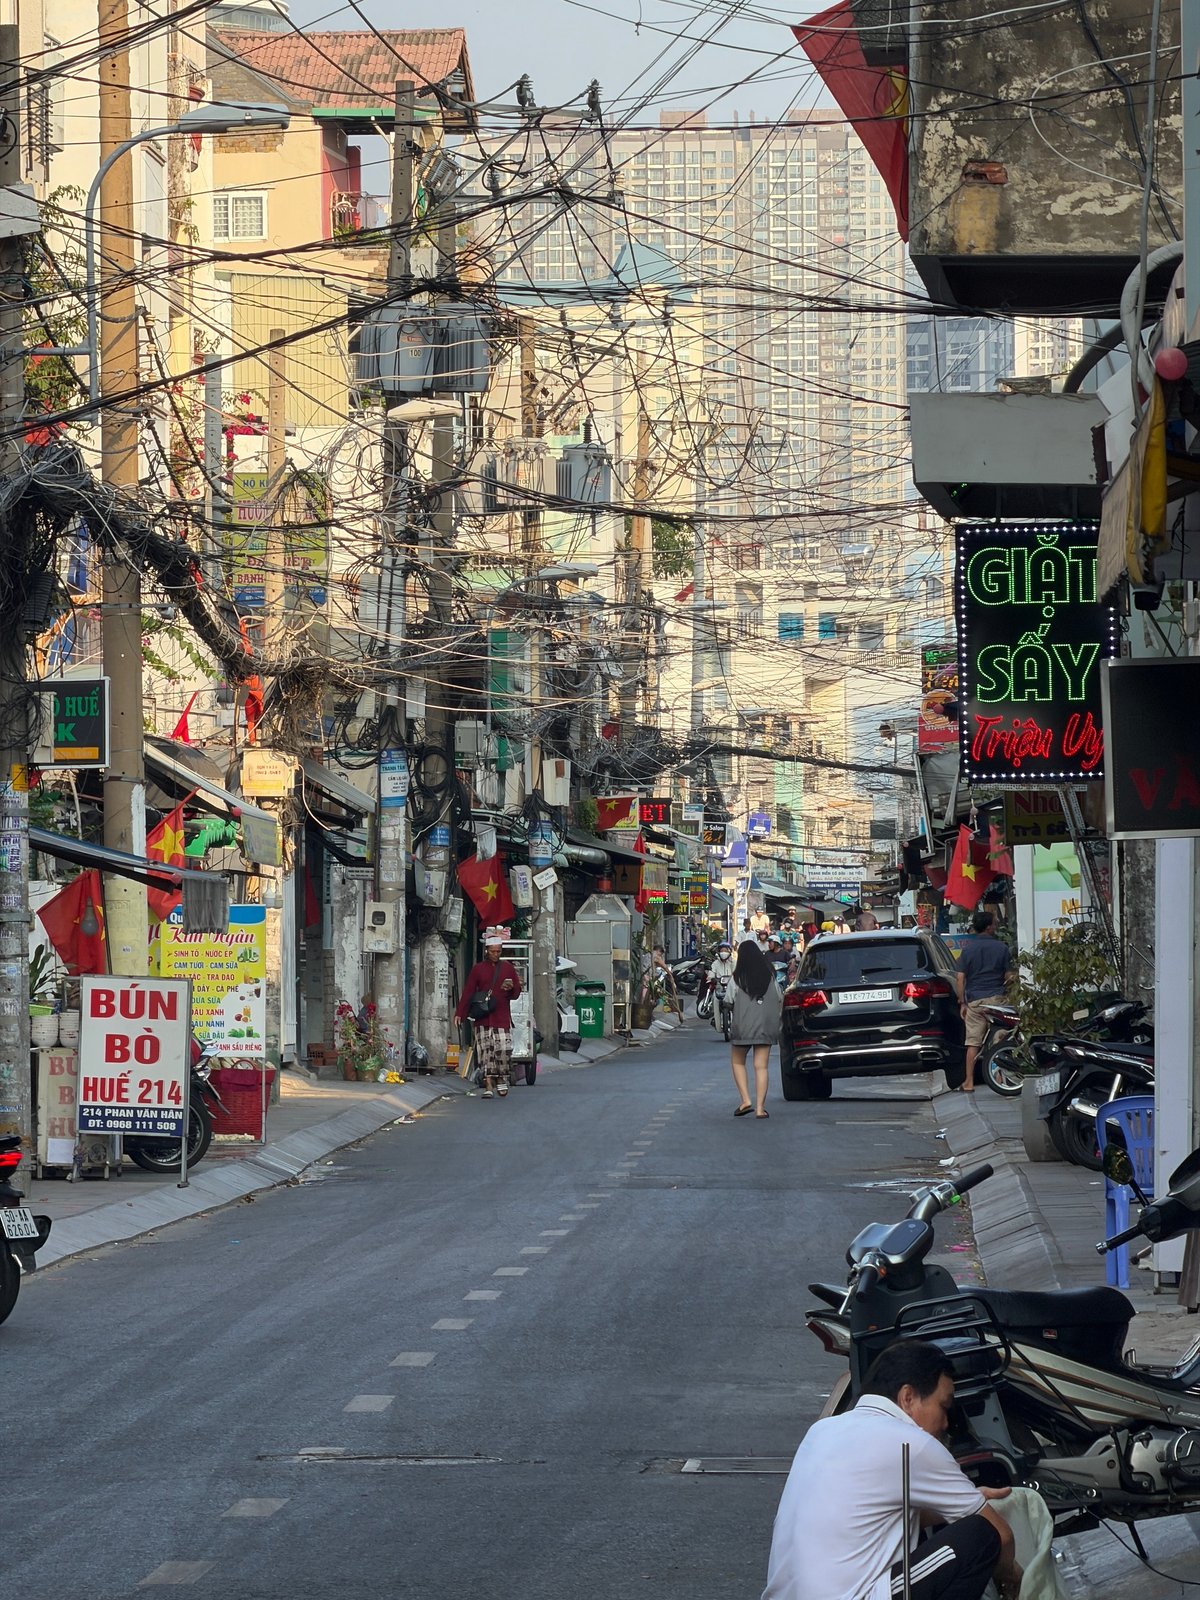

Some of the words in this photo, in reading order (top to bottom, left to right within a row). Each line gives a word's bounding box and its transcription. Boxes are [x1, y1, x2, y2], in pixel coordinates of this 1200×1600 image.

[967, 534, 1098, 618] GIẶT
[976, 623, 1101, 703] SẤY
[65, 686, 100, 717] HUẾ
[173, 961, 188, 969] CAM
[209, 961, 224, 969] CAM
[174, 950, 189, 958] SINH
[90, 983, 178, 1021] BÚN
[205, 1008, 224, 1016] XANH
[105, 1027, 160, 1065] BÒ
[82, 1070, 133, 1104] HUẾ
[137, 1078, 182, 1105] 214
[82, 1108, 102, 1117] 214
[104, 1108, 135, 1118] PHAN
[136, 1108, 158, 1119] VĂN
[160, 1109, 183, 1120] HÂN
[88, 1119, 104, 1128] ĐT:
[106, 1120, 133, 1129] 0968
[135, 1121, 153, 1130] 111
[156, 1121, 176, 1131] 508
